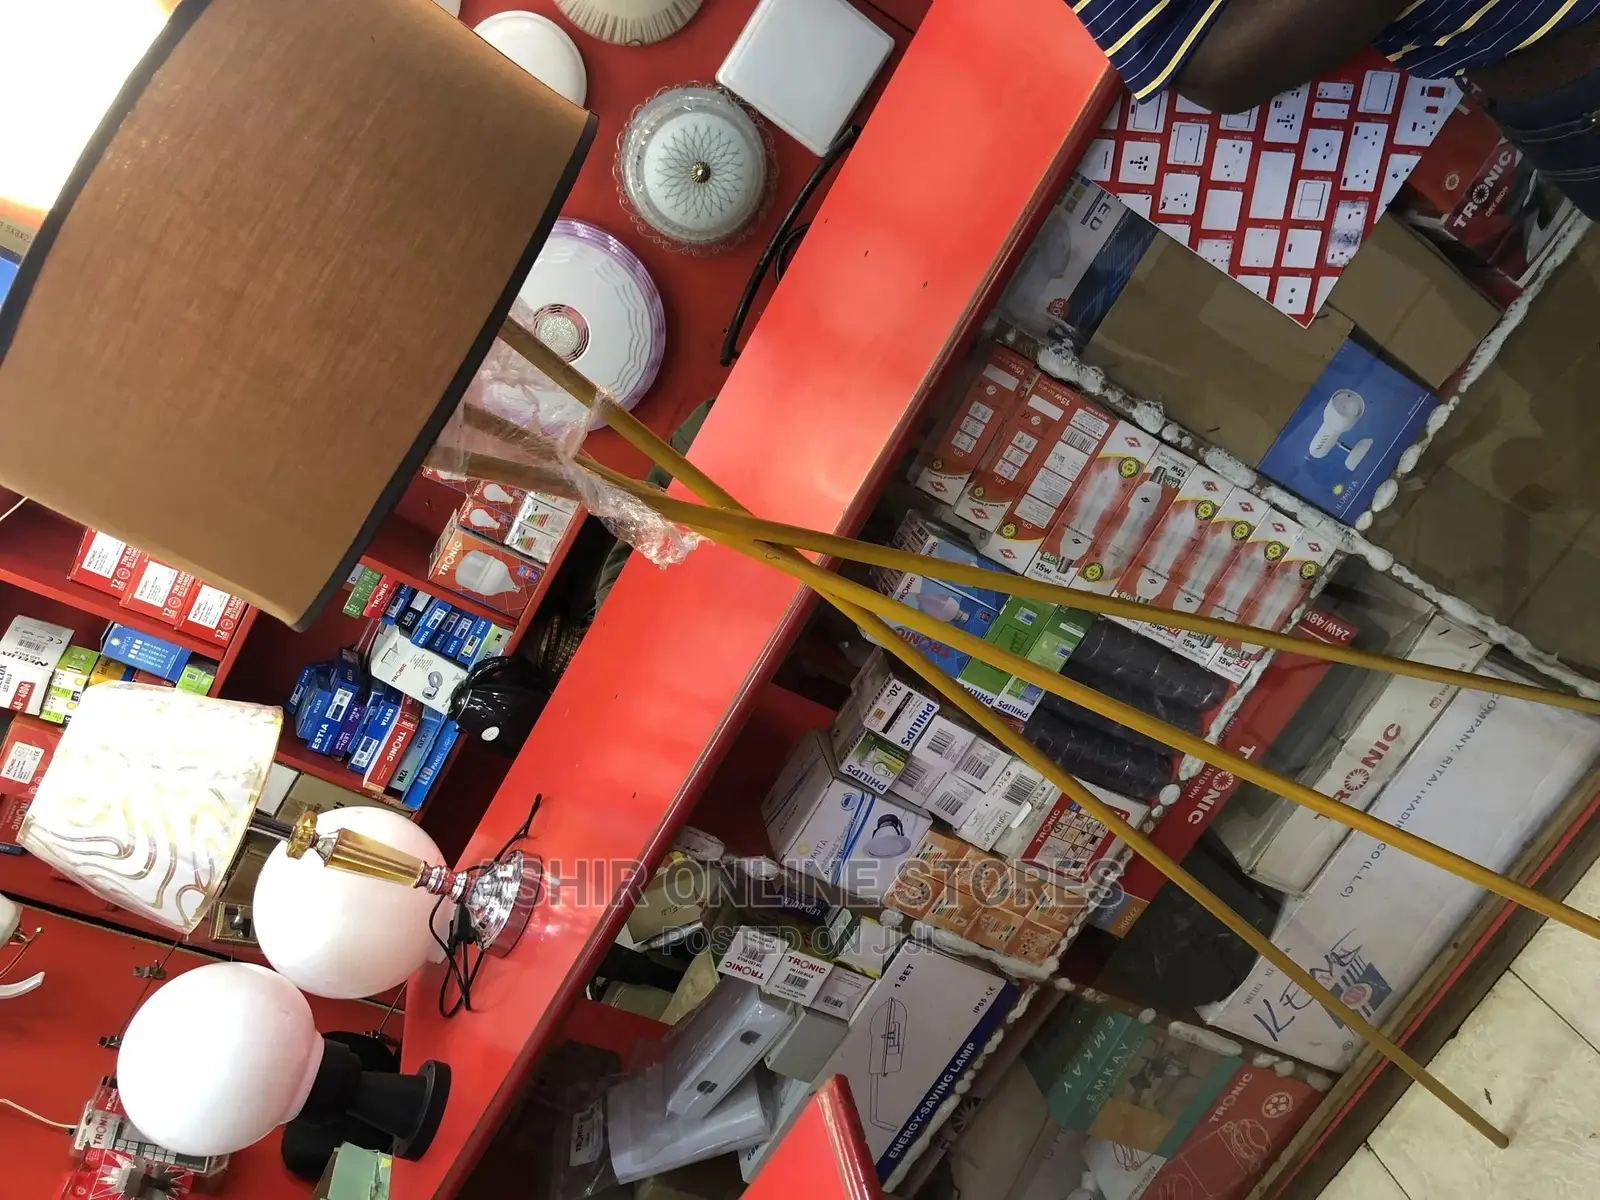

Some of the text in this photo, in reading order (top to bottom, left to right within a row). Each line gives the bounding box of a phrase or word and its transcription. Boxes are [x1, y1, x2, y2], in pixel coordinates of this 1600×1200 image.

[1453, 151, 1512, 228] TRONIC
[1334, 481, 1360, 511] ILUMITA
[460, 501, 474, 522] TRONIC
[438, 541, 463, 576] TRONIC
[371, 583, 389, 608] TRONIC
[402, 611, 414, 625] LED
[215, 629, 225, 639] 12
[418, 630, 430, 645] ESTIA
[391, 663, 407, 684] TRONIC
[381, 708, 394, 726] ESTIA
[997, 700, 1029, 719] PHILIPS
[311, 722, 329, 750] ESTIA
[900, 702, 936, 747] PHILIPS
[387, 731, 406, 762] TRONIC
[397, 769, 409, 783] 12W
[417, 767, 433, 786] LED
[432, 751, 445, 771] PANEL
[846, 764, 887, 791] PHILIPS
[1187, 744, 1257, 825] TONIC
[1036, 809, 1061, 843] TRONIC
[725, 961, 764, 980] TRONIC
[788, 955, 826, 974] TRONIC
[899, 964, 915, 983] SET
[888, 1042, 976, 1160] ENERGY-SAVING LAMP
[1208, 1072, 1253, 1125] TRONIC
[94, 1115, 108, 1145] TRONI
